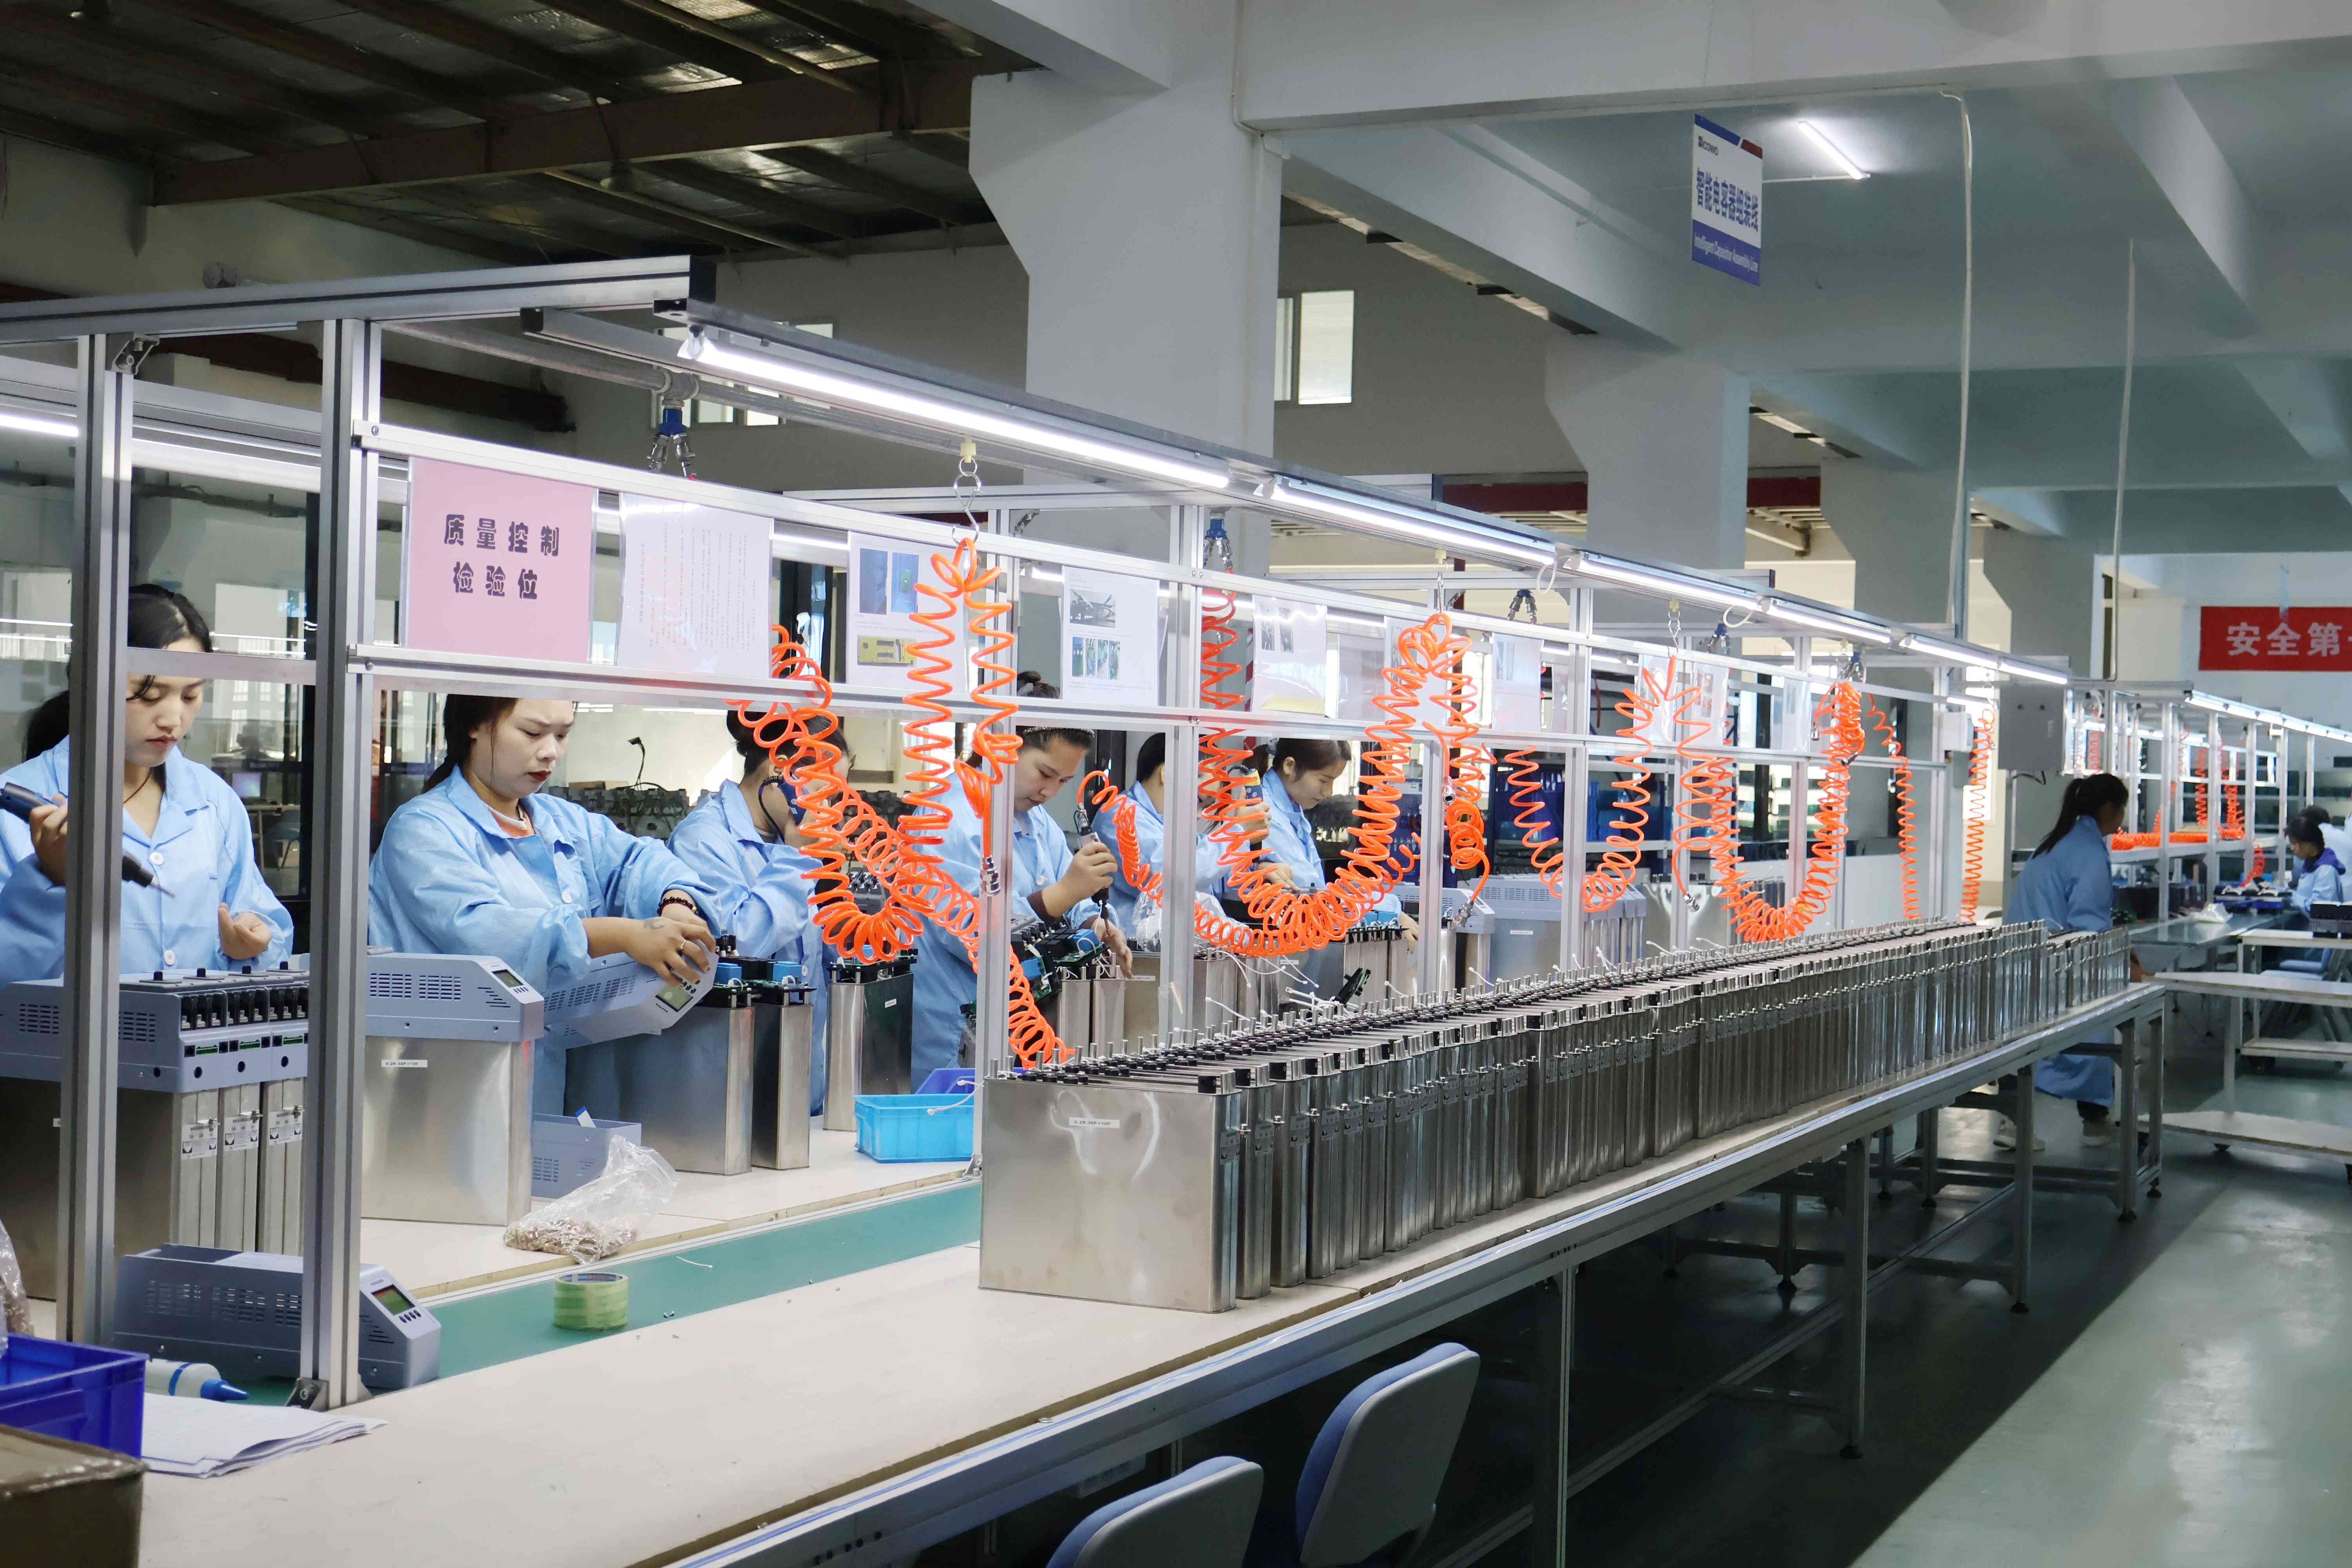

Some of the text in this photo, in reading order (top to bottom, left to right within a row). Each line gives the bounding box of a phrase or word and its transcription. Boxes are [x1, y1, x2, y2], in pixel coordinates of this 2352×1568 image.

[444, 514, 559, 557] 质量控制
[453, 561, 537, 599] 检验位
[2227, 622, 2352, 657] 安全第
